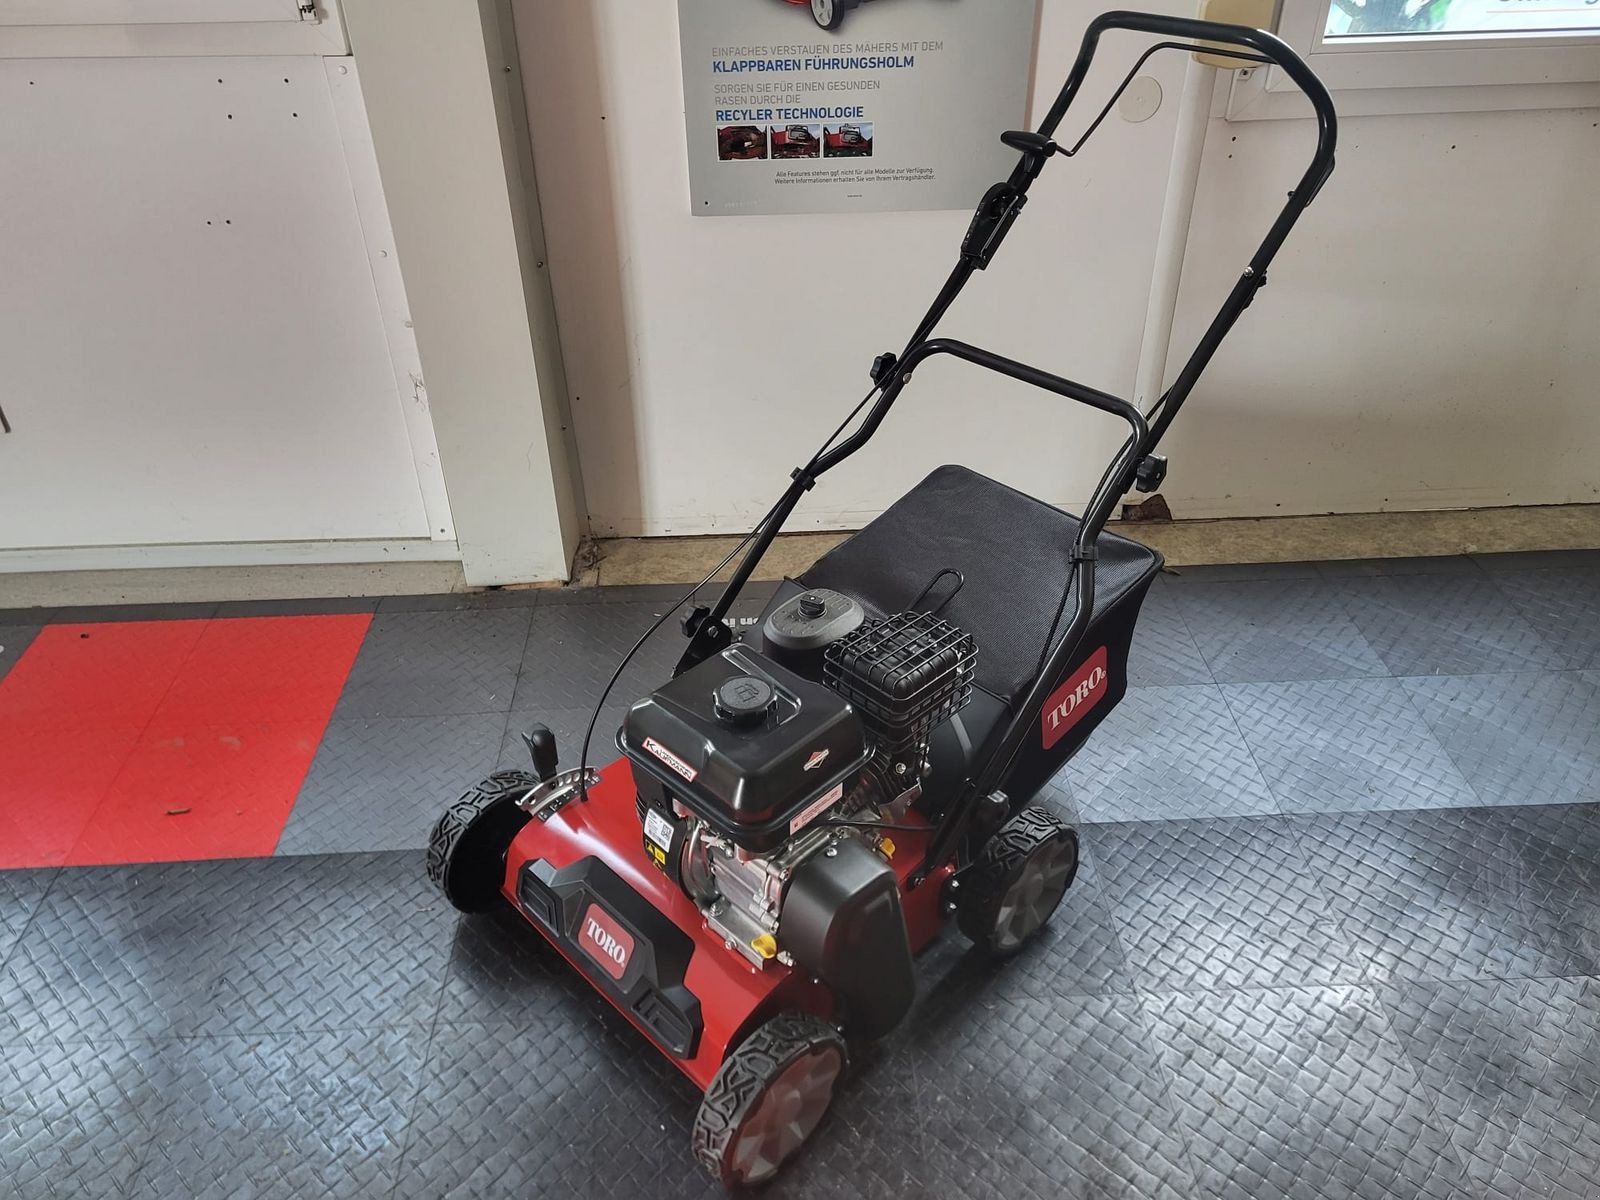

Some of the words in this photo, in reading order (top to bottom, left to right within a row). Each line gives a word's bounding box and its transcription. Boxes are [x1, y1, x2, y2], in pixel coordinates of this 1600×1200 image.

[712, 46, 768, 57] EINFACHES
[770, 44, 830, 56] VERSTAUEN
[832, 43, 853, 54] DES
[901, 41, 919, 52] MIT
[921, 41, 944, 51] DEM
[713, 59, 801, 73] KLAPPBAREN
[804, 55, 914, 71] FÜHRUNGSHOLM
[714, 83, 754, 94] SORGEN
[756, 82, 772, 93] SIE
[773, 80, 794, 93] FÜR
[795, 81, 825, 92] EINEN
[827, 80, 880, 91] GESUNDEN
[715, 95, 748, 106] RASEN
[750, 94, 783, 105] DURCH
[785, 94, 801, 104] DIE
[716, 108, 773, 121] RECYLER
[776, 106, 864, 120] TECHNOLOGIE
[812, 169, 830, 177] stehen
[841, 168, 854, 176] nicht
[875, 167, 896, 175] Modelle
[775, 177, 795, 185] Weitere
[587, 917, 626, 964] TORO
